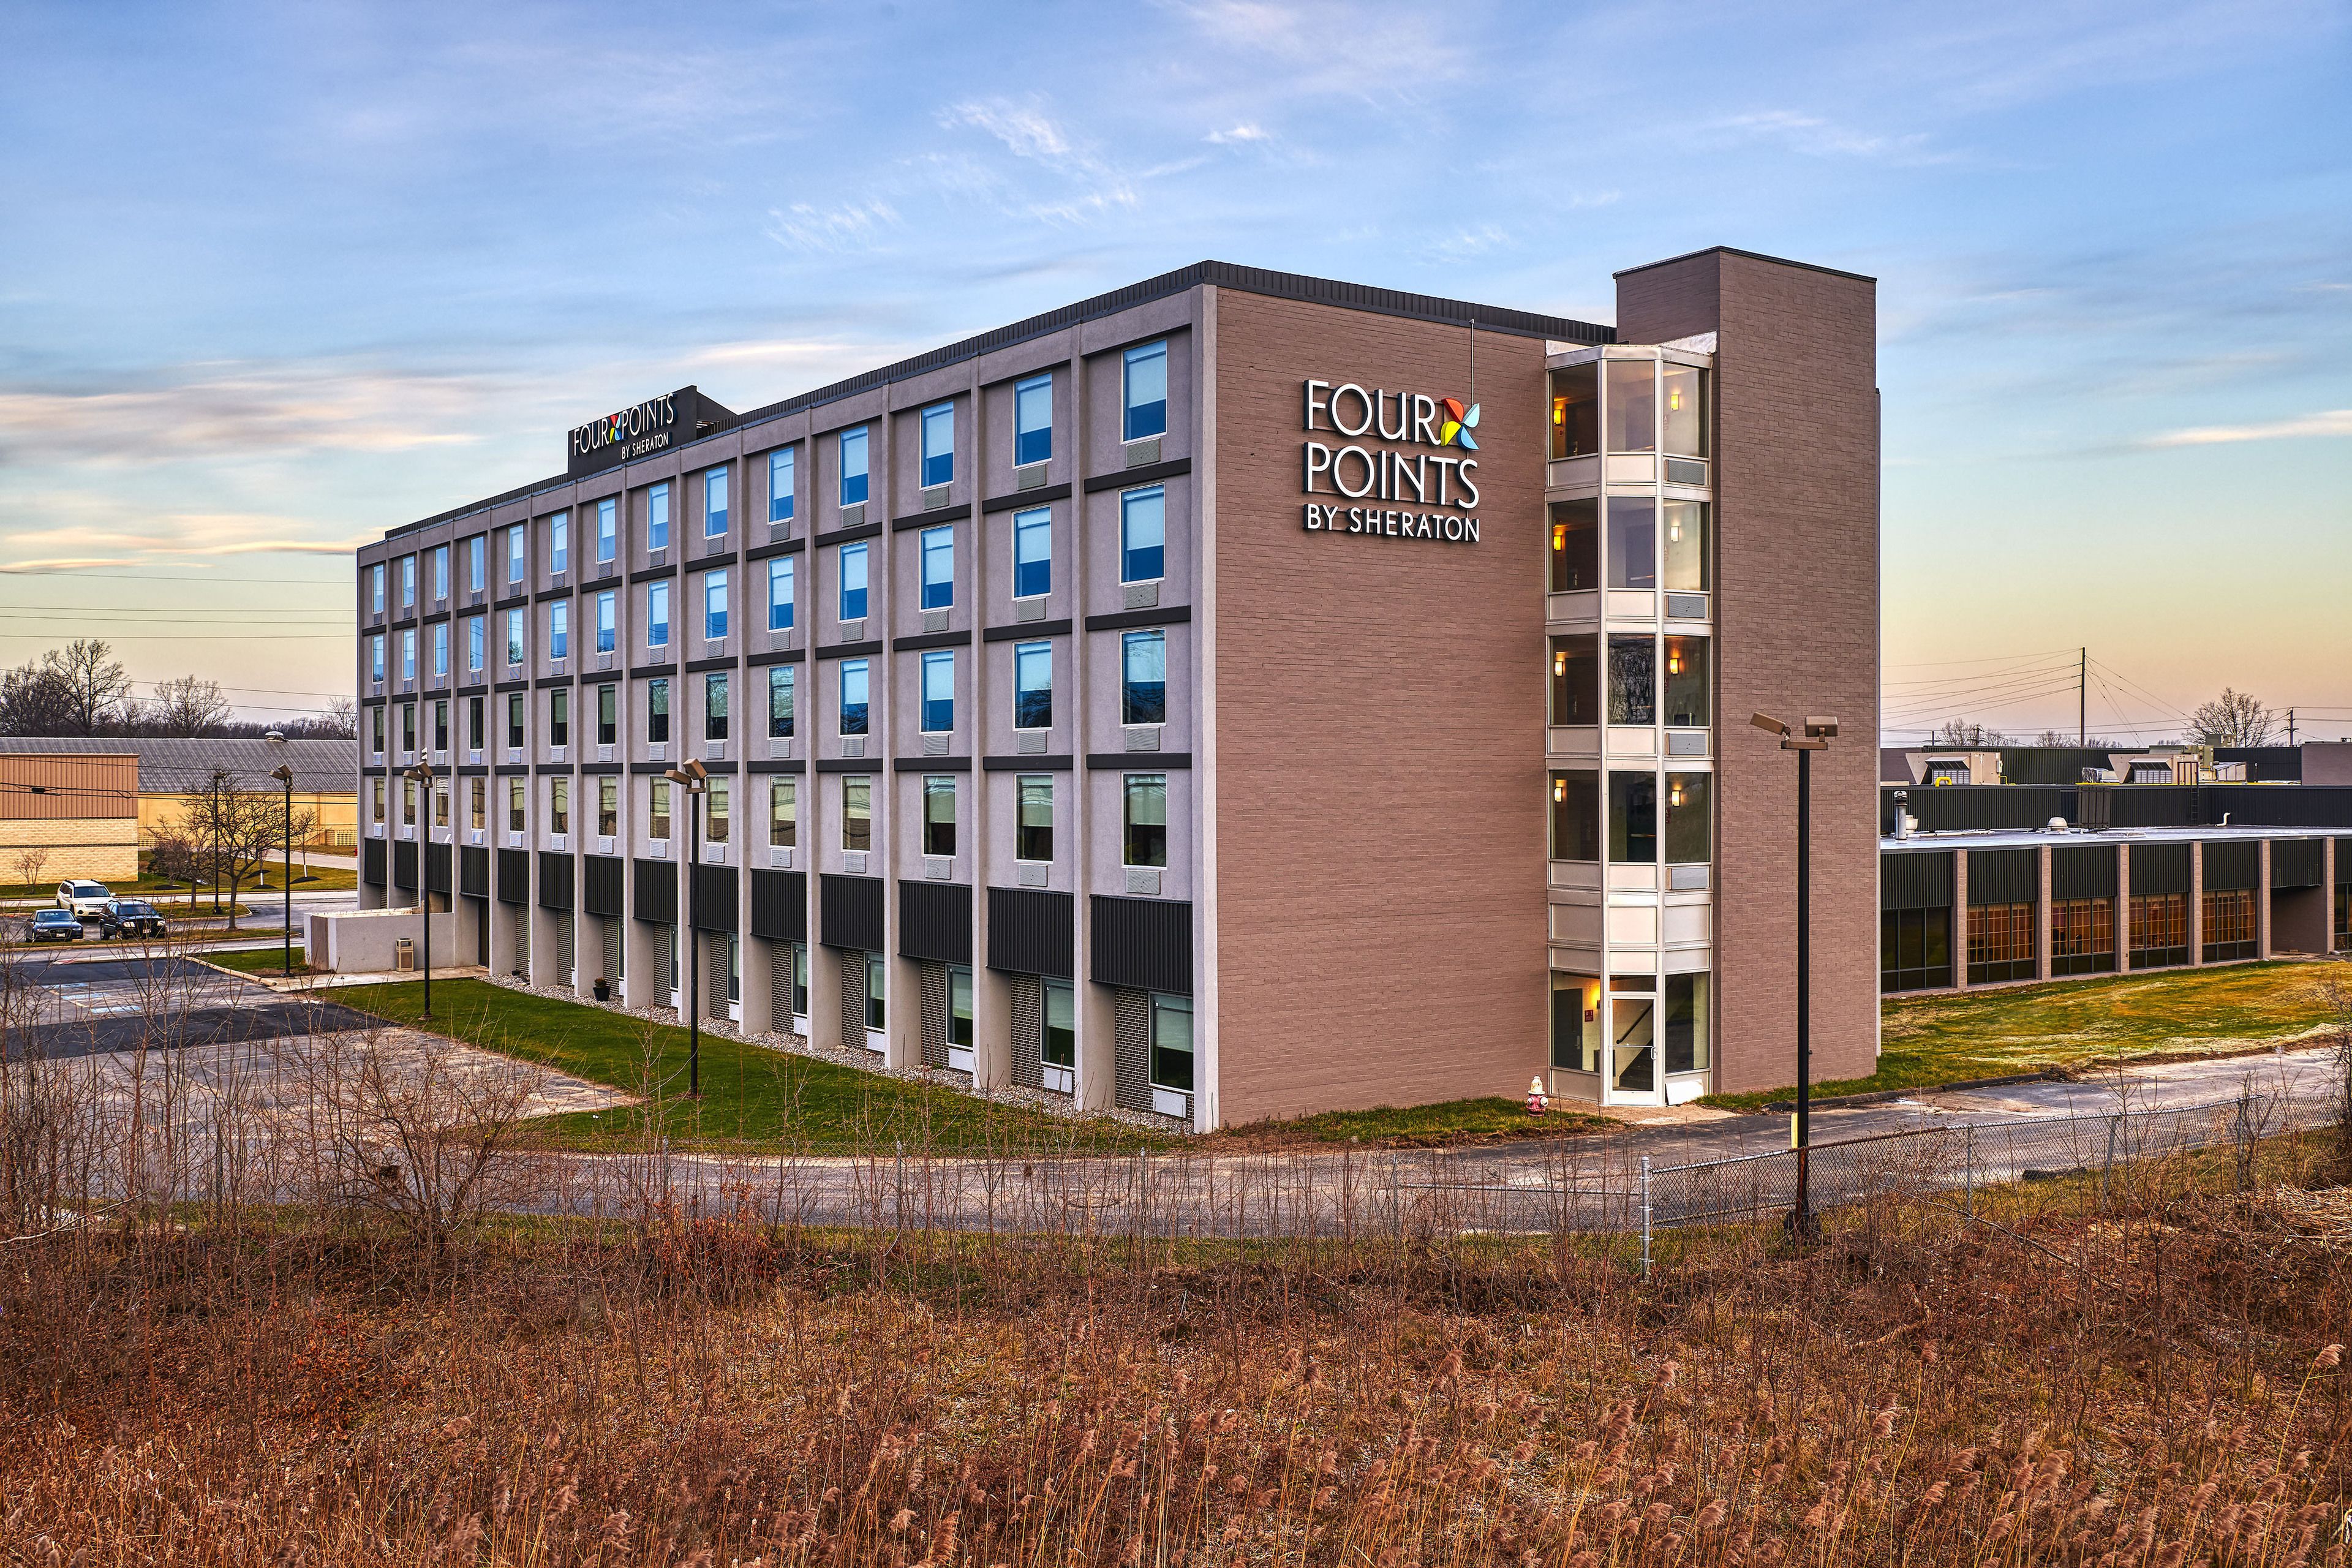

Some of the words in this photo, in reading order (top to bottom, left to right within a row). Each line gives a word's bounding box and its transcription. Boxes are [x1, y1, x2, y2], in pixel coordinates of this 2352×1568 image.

[573, 418, 610, 456] FOUR
[621, 393, 674, 439] POINTS
[1304, 379, 1441, 445] FOUR
[621, 444, 630, 459] BY
[632, 431, 669, 456] SHERATON
[1304, 442, 1480, 509] POINTS
[1304, 504, 1339, 530] BY
[1349, 507, 1480, 542] SHERATON
